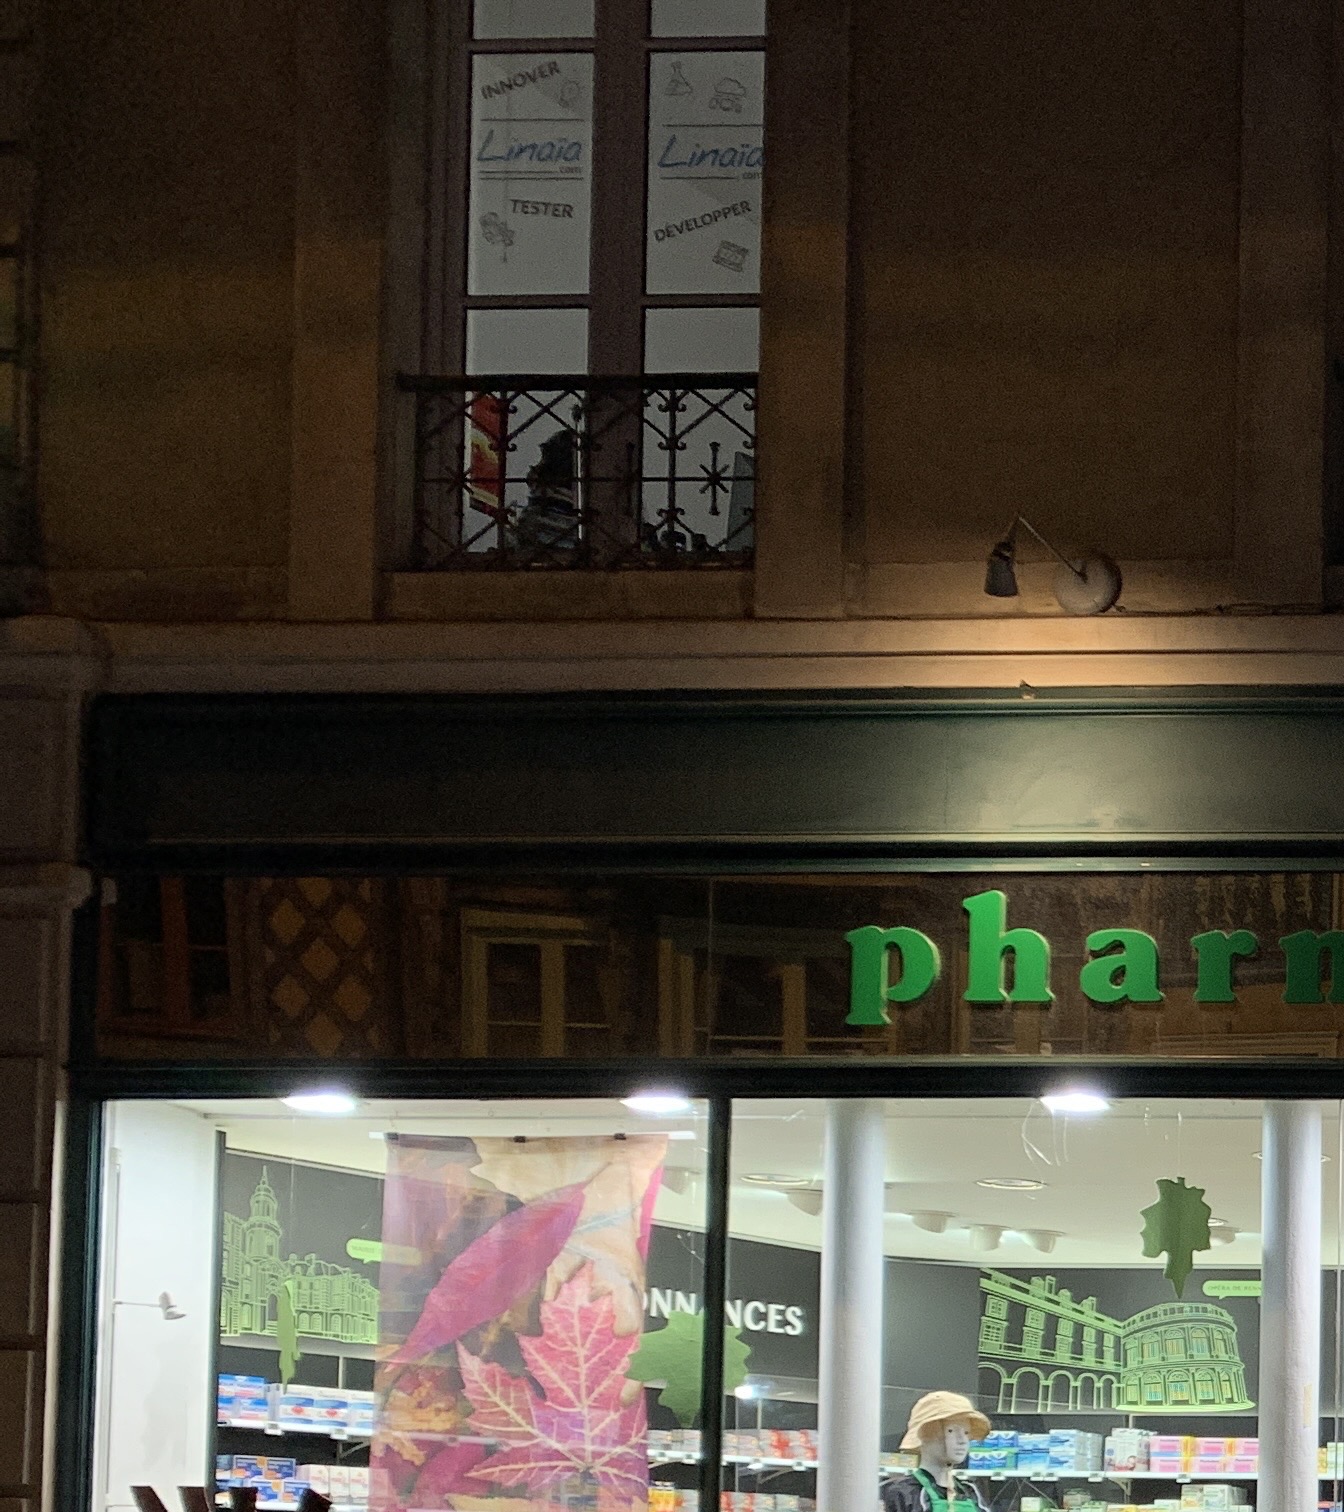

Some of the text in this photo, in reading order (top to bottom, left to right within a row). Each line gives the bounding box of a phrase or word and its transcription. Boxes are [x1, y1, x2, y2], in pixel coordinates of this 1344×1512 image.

[481, 61, 561, 99] INNOVER
[511, 200, 573, 218] TESTER
[654, 200, 752, 242] DEVELOPPER
